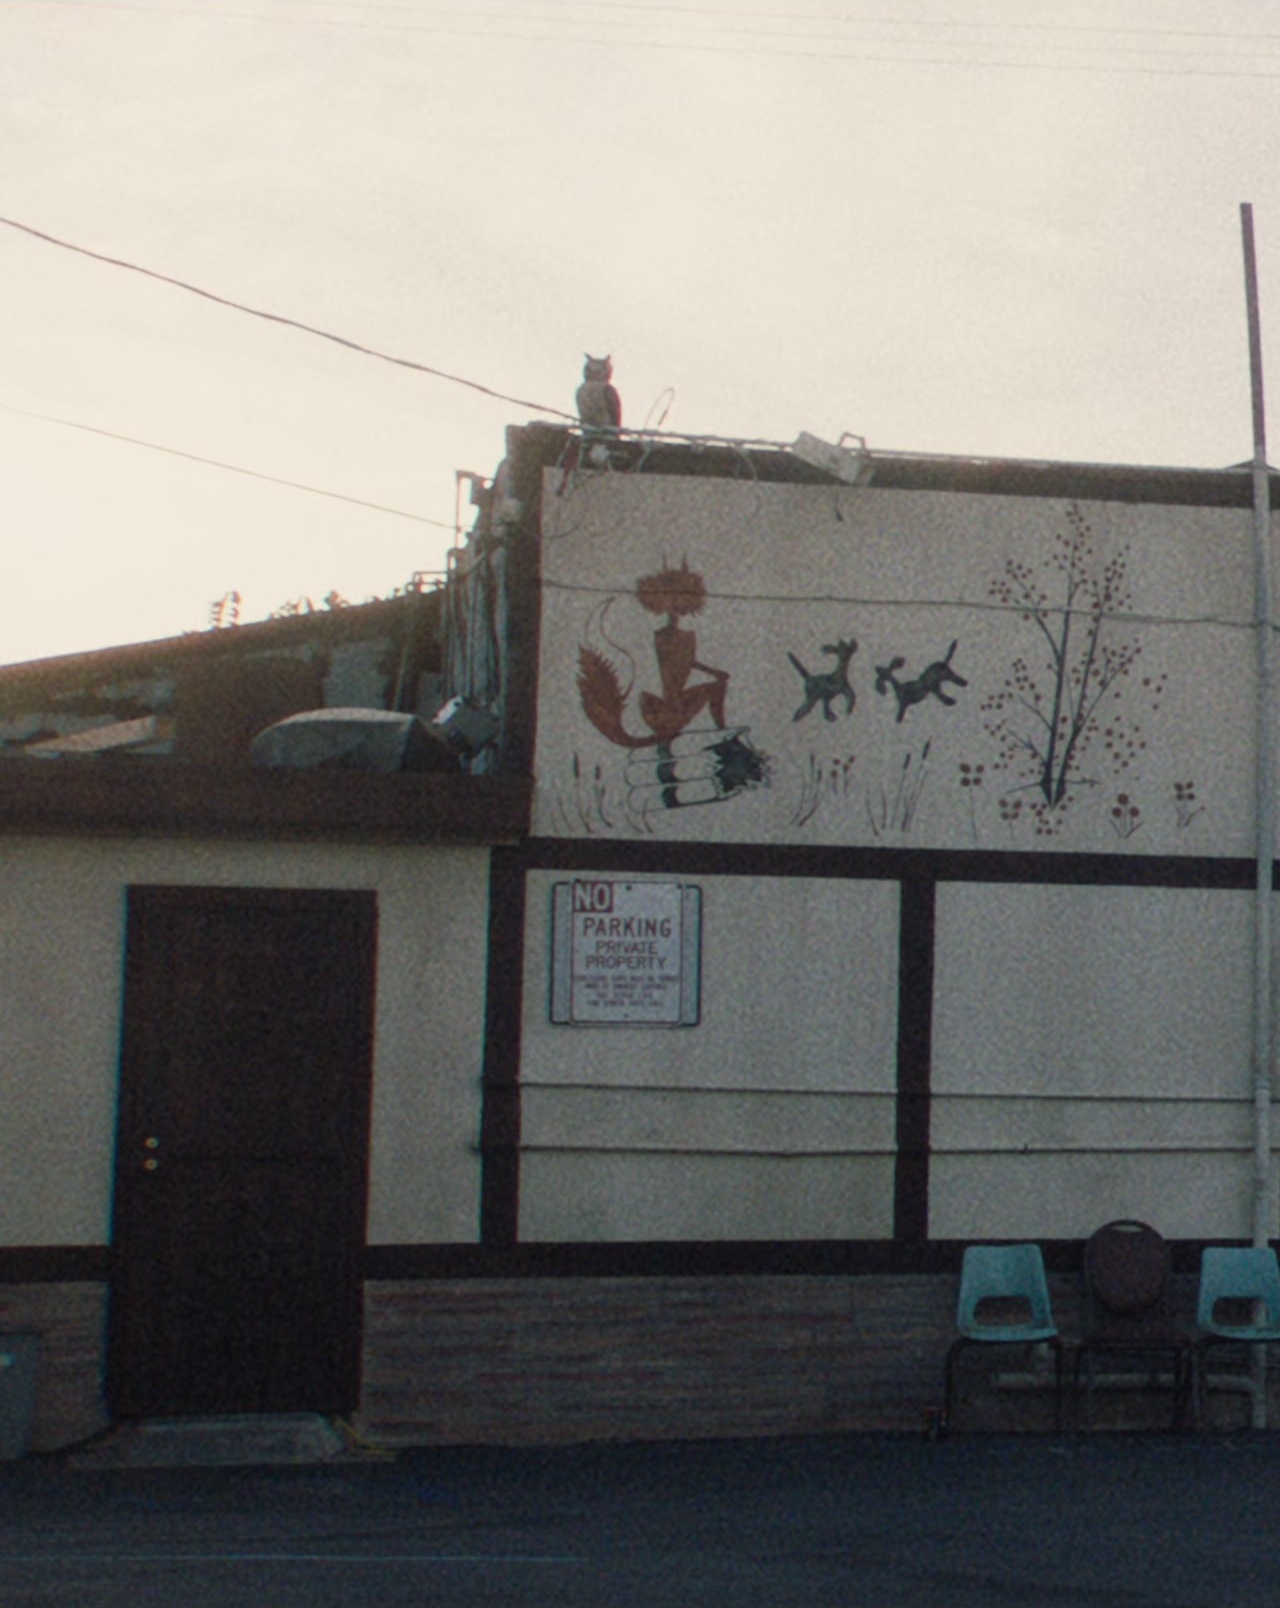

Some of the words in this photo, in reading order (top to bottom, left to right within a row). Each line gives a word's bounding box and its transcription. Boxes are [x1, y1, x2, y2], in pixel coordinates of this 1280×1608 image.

[575, 884, 612, 911] NO
[583, 917, 672, 938] PARKING
[595, 941, 658, 955] PRIVATE
[585, 956, 668, 970] PROPERTY
